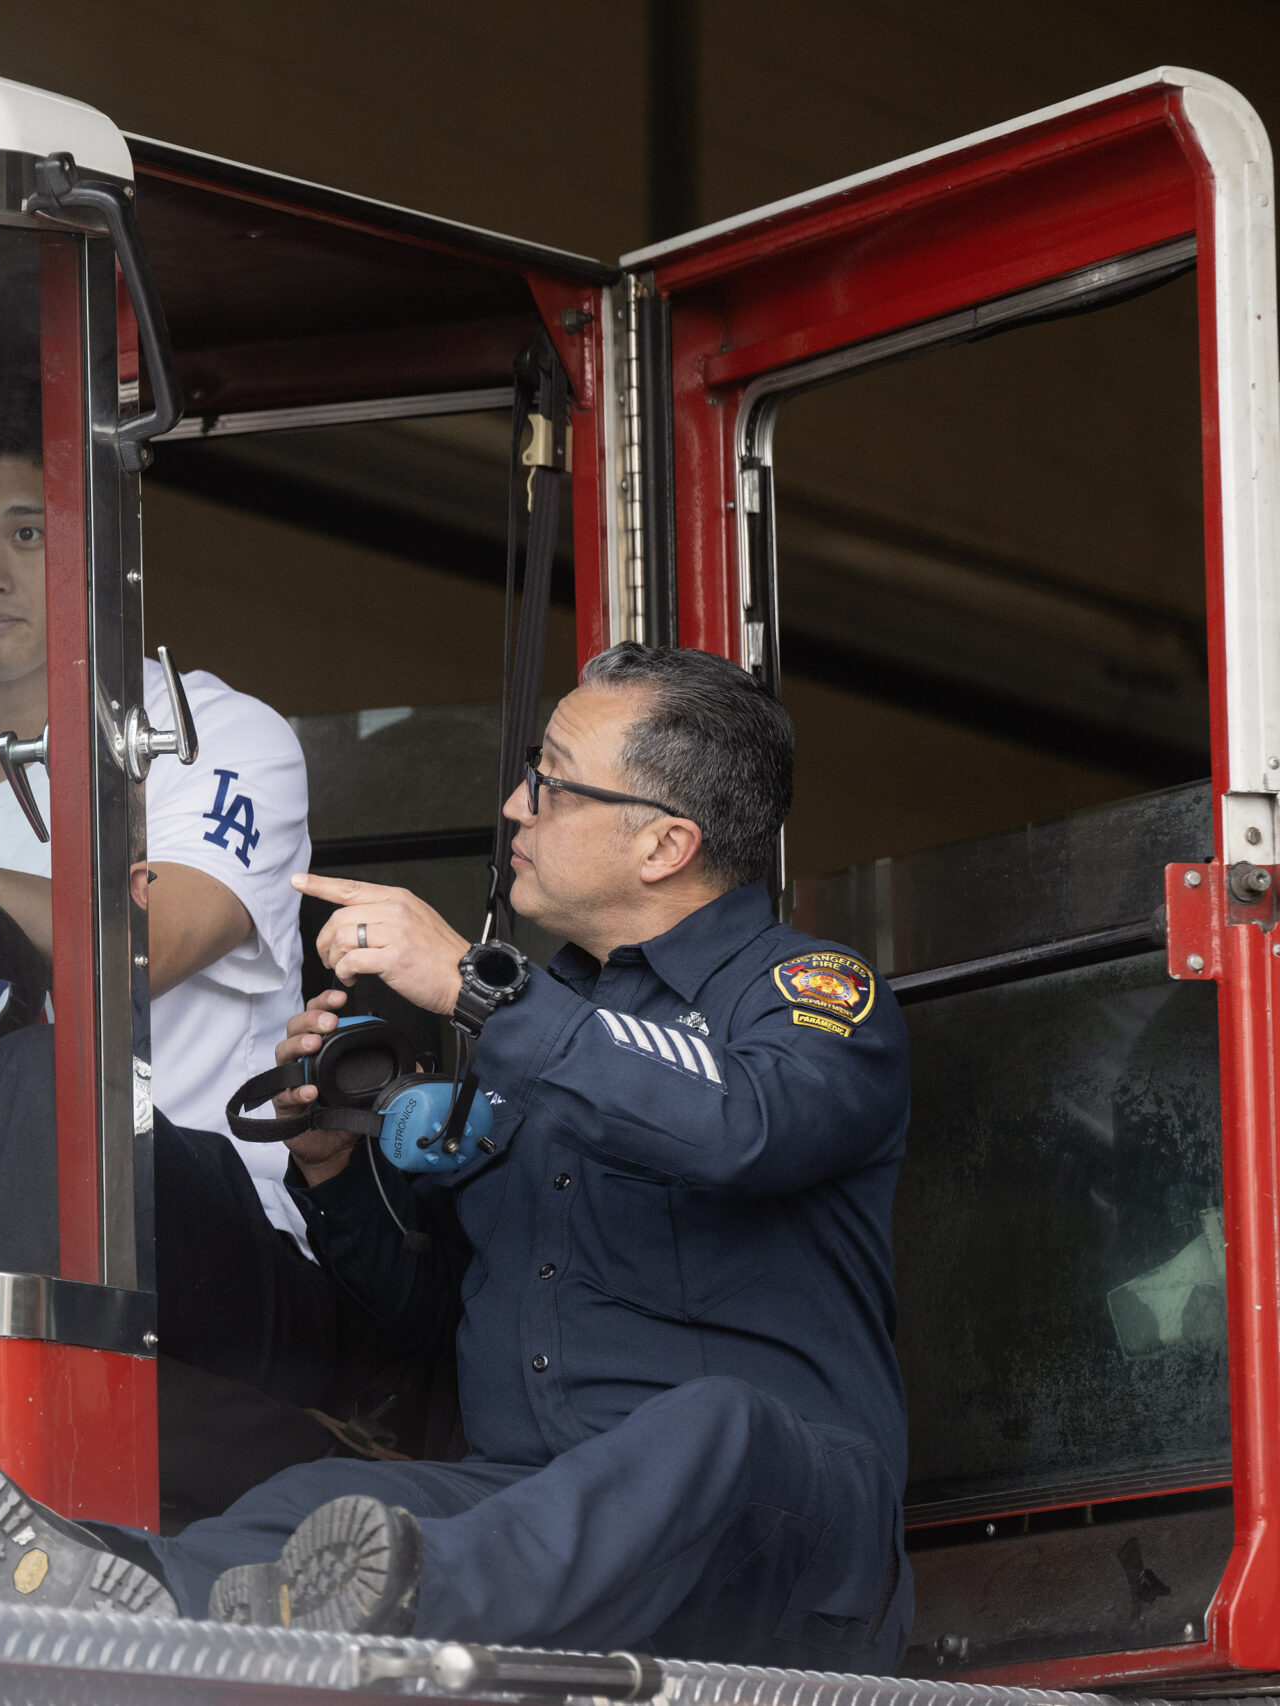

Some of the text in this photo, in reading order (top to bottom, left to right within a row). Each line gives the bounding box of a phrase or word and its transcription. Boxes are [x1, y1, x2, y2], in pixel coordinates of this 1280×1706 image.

[202, 769, 260, 869] LA
[783, 955, 867, 978] LOS ANGELES
[812, 960, 841, 971] FIRE
[797, 997, 853, 1019] DEPARTMENT
[799, 1016, 845, 1035] PARAMEDIC
[394, 1098, 417, 1159] SIGTRONICS
